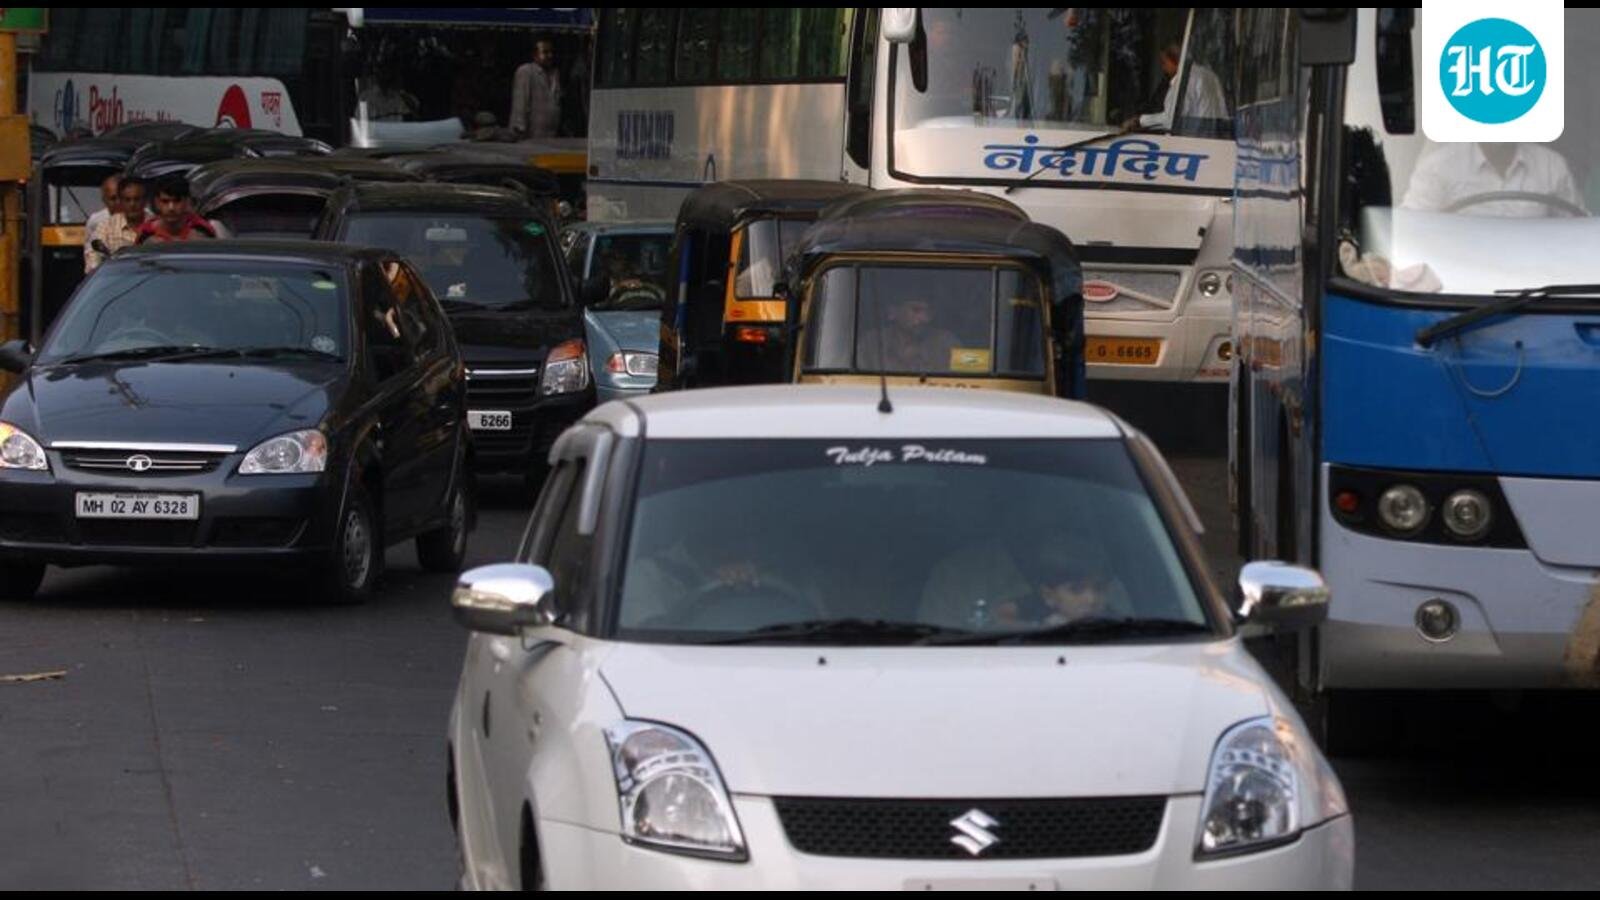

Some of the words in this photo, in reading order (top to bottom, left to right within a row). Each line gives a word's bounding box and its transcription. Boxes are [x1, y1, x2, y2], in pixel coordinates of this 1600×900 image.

[983, 134, 1209, 182] नंदादिप
[480, 414, 510, 428] 6266
[826, 446, 895, 467] Tulja
[901, 443, 987, 465] Pritam
[82, 499, 104, 514] MH
[110, 500, 127, 514] 02
[131, 500, 149, 514] AY
[153, 501, 188, 514] 6328
